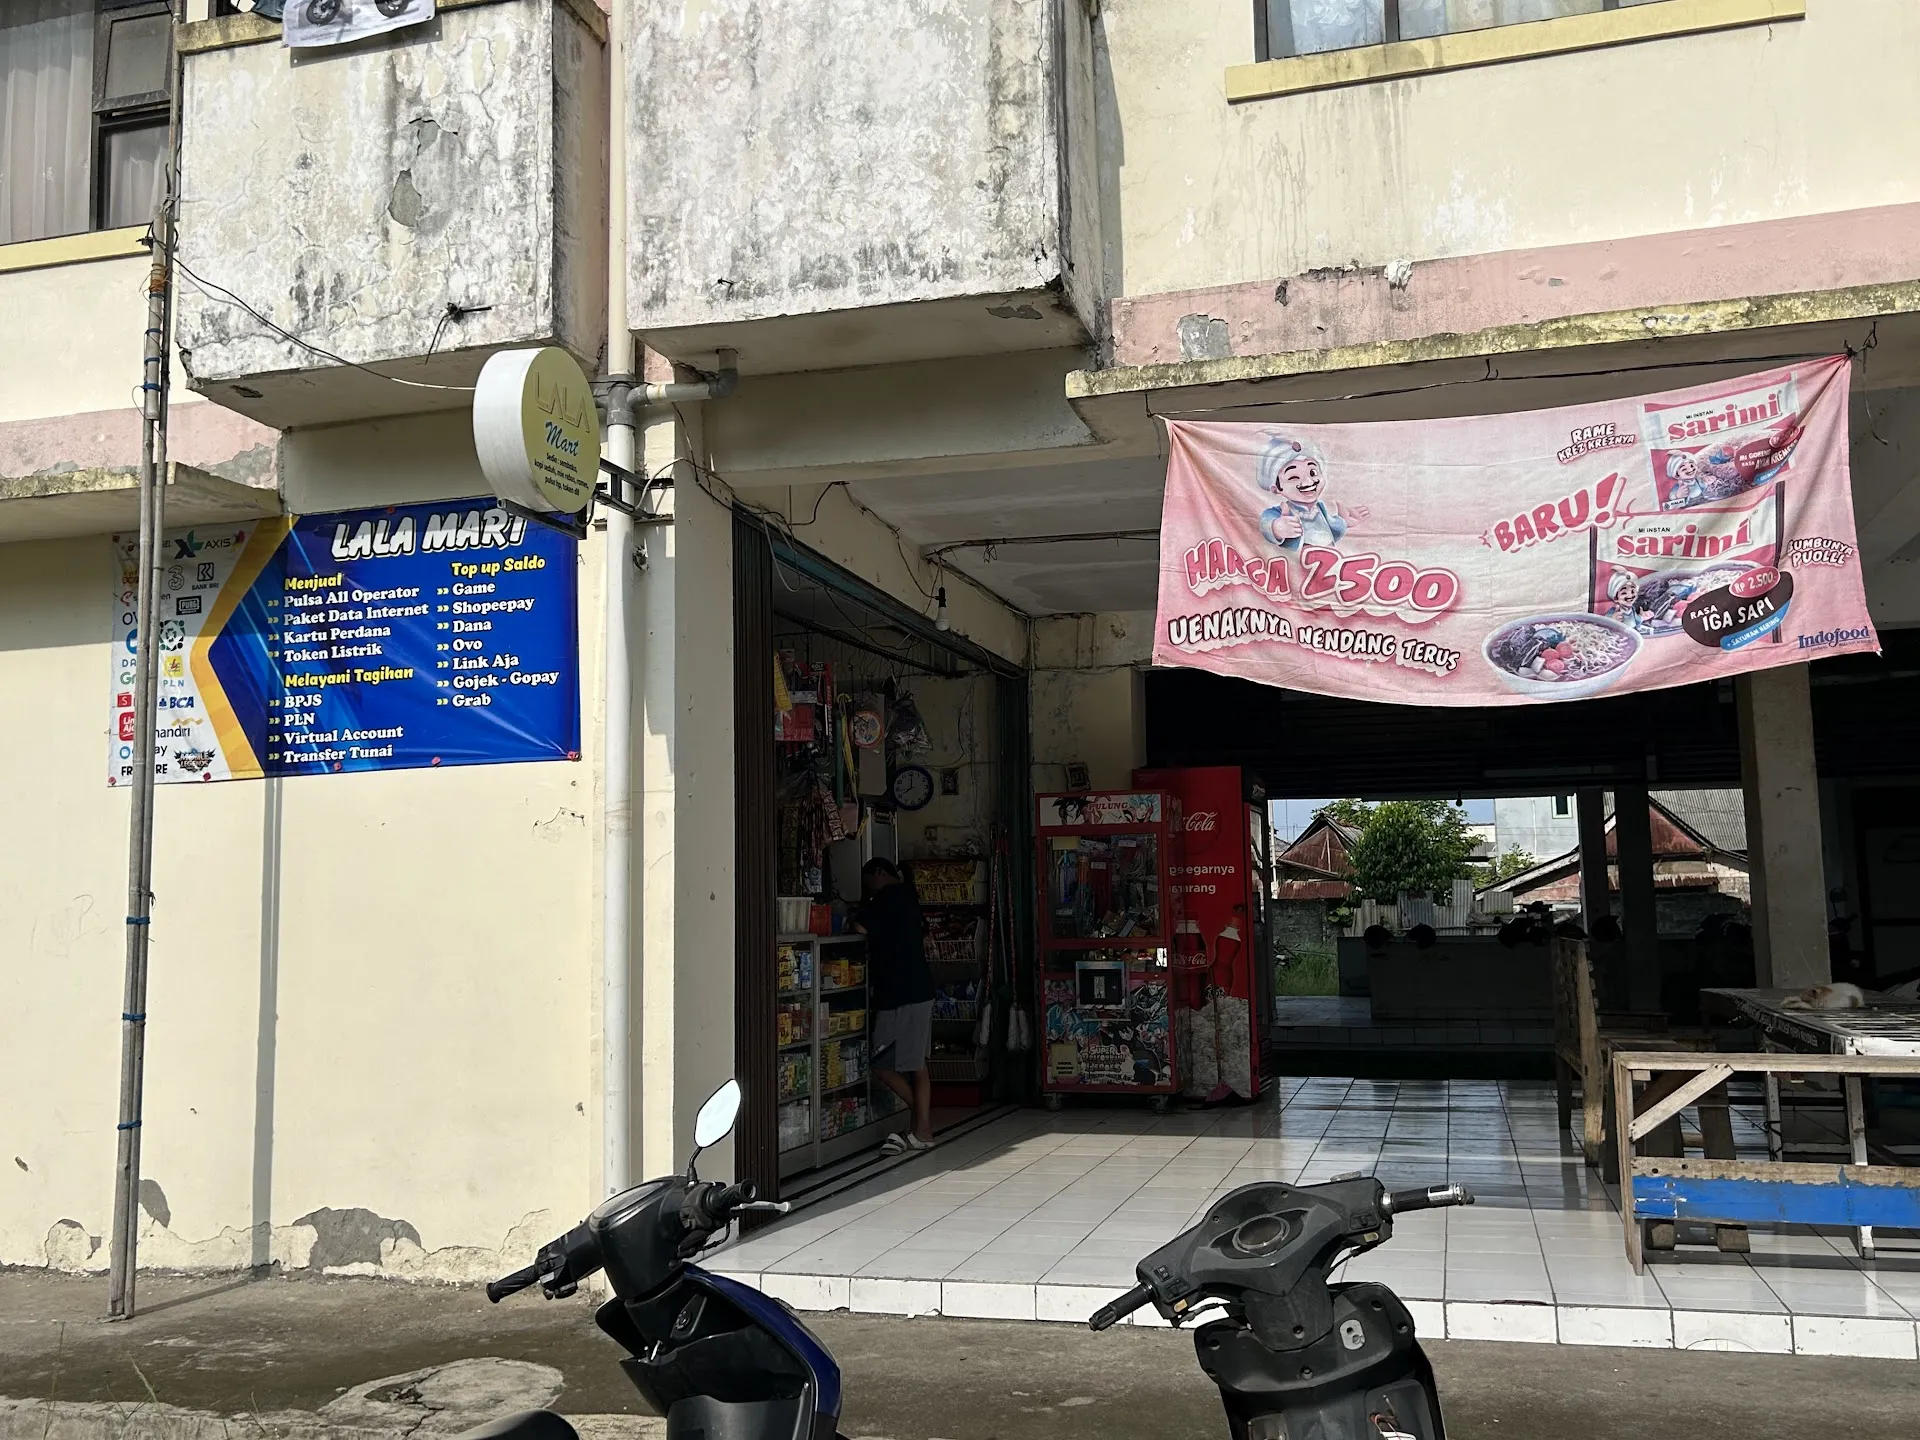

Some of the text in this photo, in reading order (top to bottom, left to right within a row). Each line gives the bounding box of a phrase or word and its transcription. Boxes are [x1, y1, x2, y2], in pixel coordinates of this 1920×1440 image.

[533, 371, 590, 433] LALA
[1668, 394, 1780, 441] sarimi
[1693, 410, 1714, 418] INSTAN
[545, 421, 579, 457] Mart
[1571, 422, 1615, 444] RAME
[1557, 433, 1636, 462] KREZ KREZNYA
[1494, 471, 1622, 553] BARU!
[204, 537, 231, 550] AXIS
[330, 508, 528, 562] LALA MART
[1616, 517, 1752, 558] sarimi
[452, 555, 546, 578] Top up Saldo
[1184, 538, 1291, 596] HARGA
[1792, 550, 1846, 567] PUOLLL
[167, 564, 185, 591] 3
[284, 571, 343, 592] Menjual
[1302, 548, 1458, 609] 2500
[284, 586, 420, 609] Pulsa All Operator
[452, 582, 496, 597] Game
[284, 603, 429, 626] Paket Data Internet
[452, 597, 536, 615] Shopeepay
[1690, 604, 1718, 620] RASA
[1702, 596, 1775, 632] IGA SAPI
[284, 625, 392, 645] Kartu Perdana
[452, 619, 493, 634] Dana
[1730, 616, 1781, 647] SAYURAN KERING
[452, 638, 483, 652] Ovo
[1168, 609, 1461, 671] UENAKNYA NENDANG TERUS
[1797, 626, 1870, 649] Indofood
[284, 643, 383, 663] Token Listrik
[452, 654, 520, 671] Link Aja
[163, 679, 185, 687] PLN
[284, 667, 414, 690] Melayani Tagihan
[452, 674, 499, 691] Gojek
[510, 671, 560, 687] Gopay
[169, 696, 195, 709] BCA
[284, 693, 323, 709] BPJS
[452, 692, 492, 707] Grab
[284, 712, 316, 727] PLN
[284, 726, 404, 745] Virtual Account
[284, 744, 393, 764] Transfer Tunai
